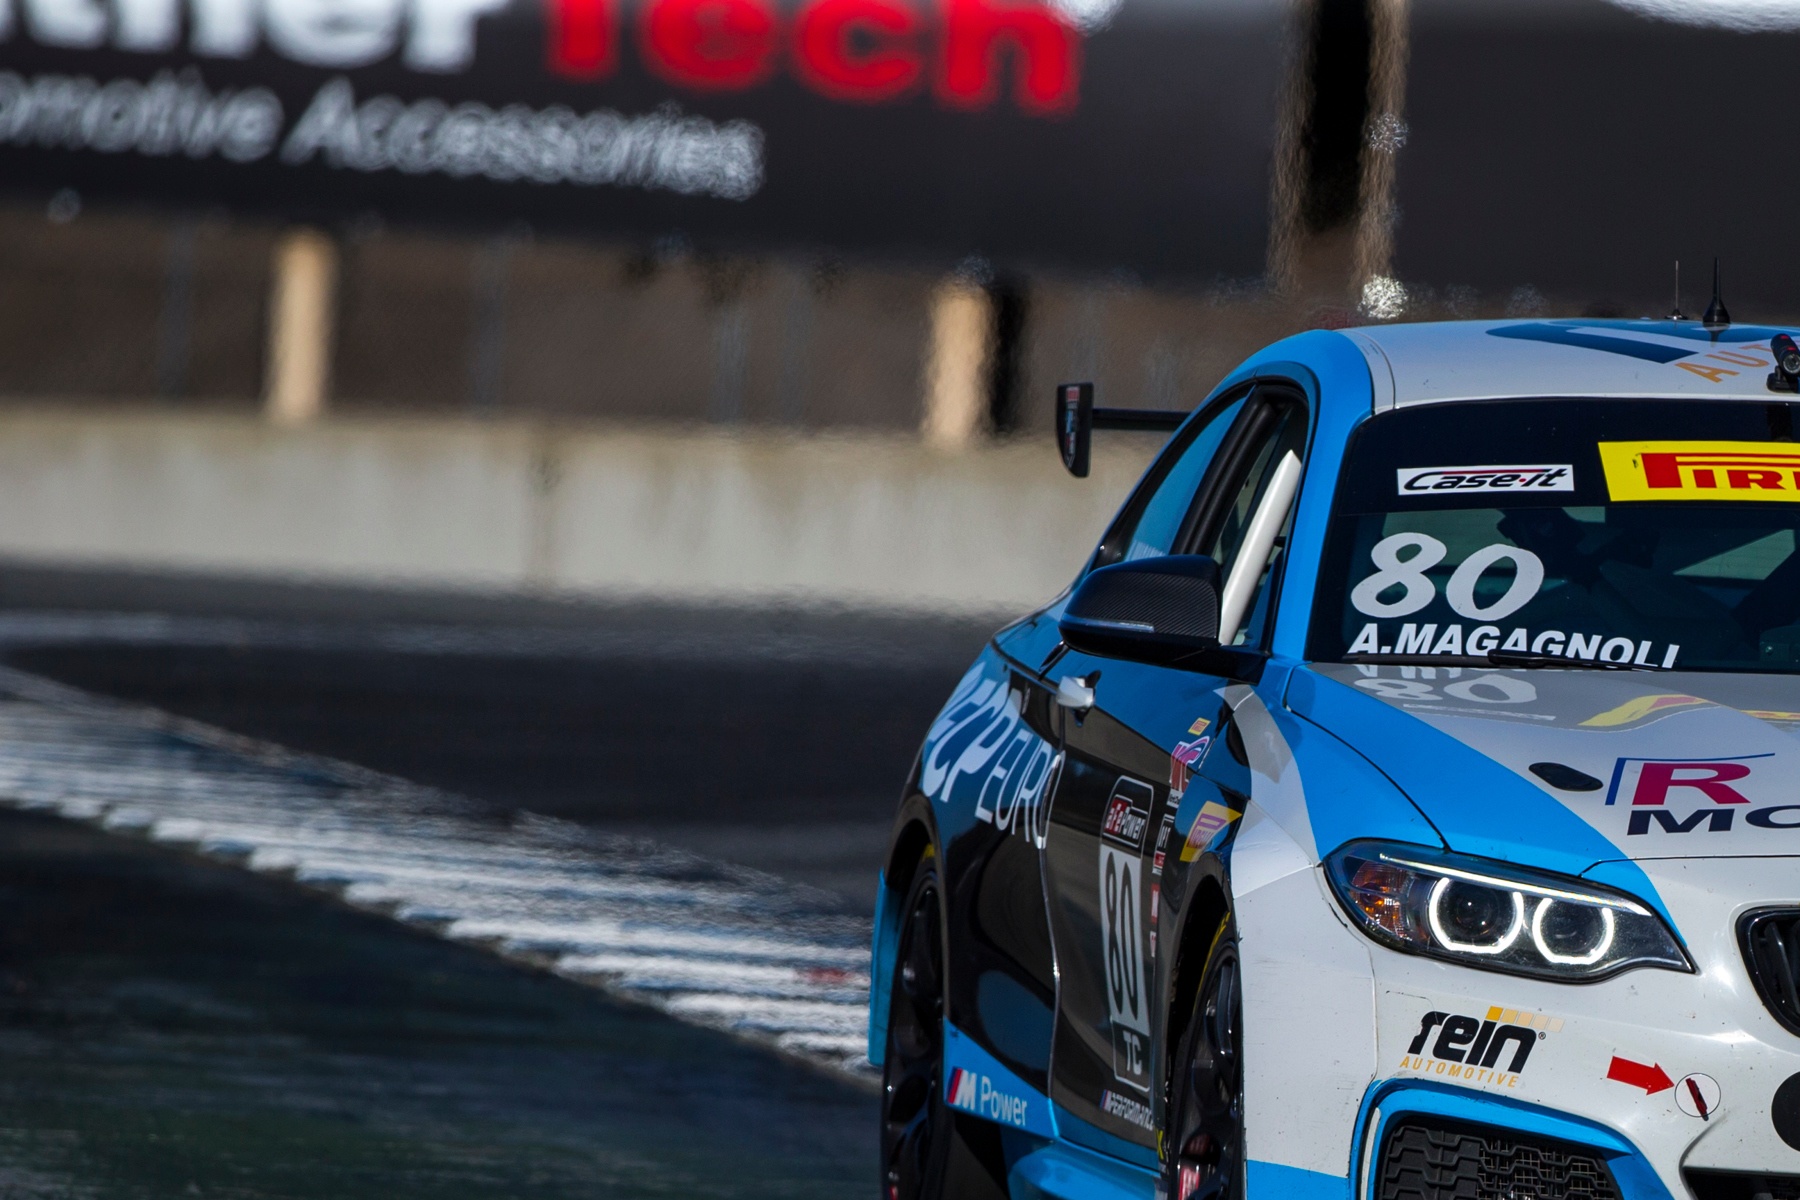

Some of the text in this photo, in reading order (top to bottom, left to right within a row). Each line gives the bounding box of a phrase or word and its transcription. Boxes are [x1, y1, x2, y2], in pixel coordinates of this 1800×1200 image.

[280, 77, 767, 200] Accessories
[1350, 531, 1545, 622] 80
[1347, 622, 1681, 669] A.MAGAGNOLI
[1105, 851, 1139, 1021] 80
[1123, 1030, 1143, 1076] TC
[1406, 1006, 1538, 1074] rein
[980, 1075, 1028, 1127] Power
[1400, 1055, 1520, 1089] AUTOMOTIVE
